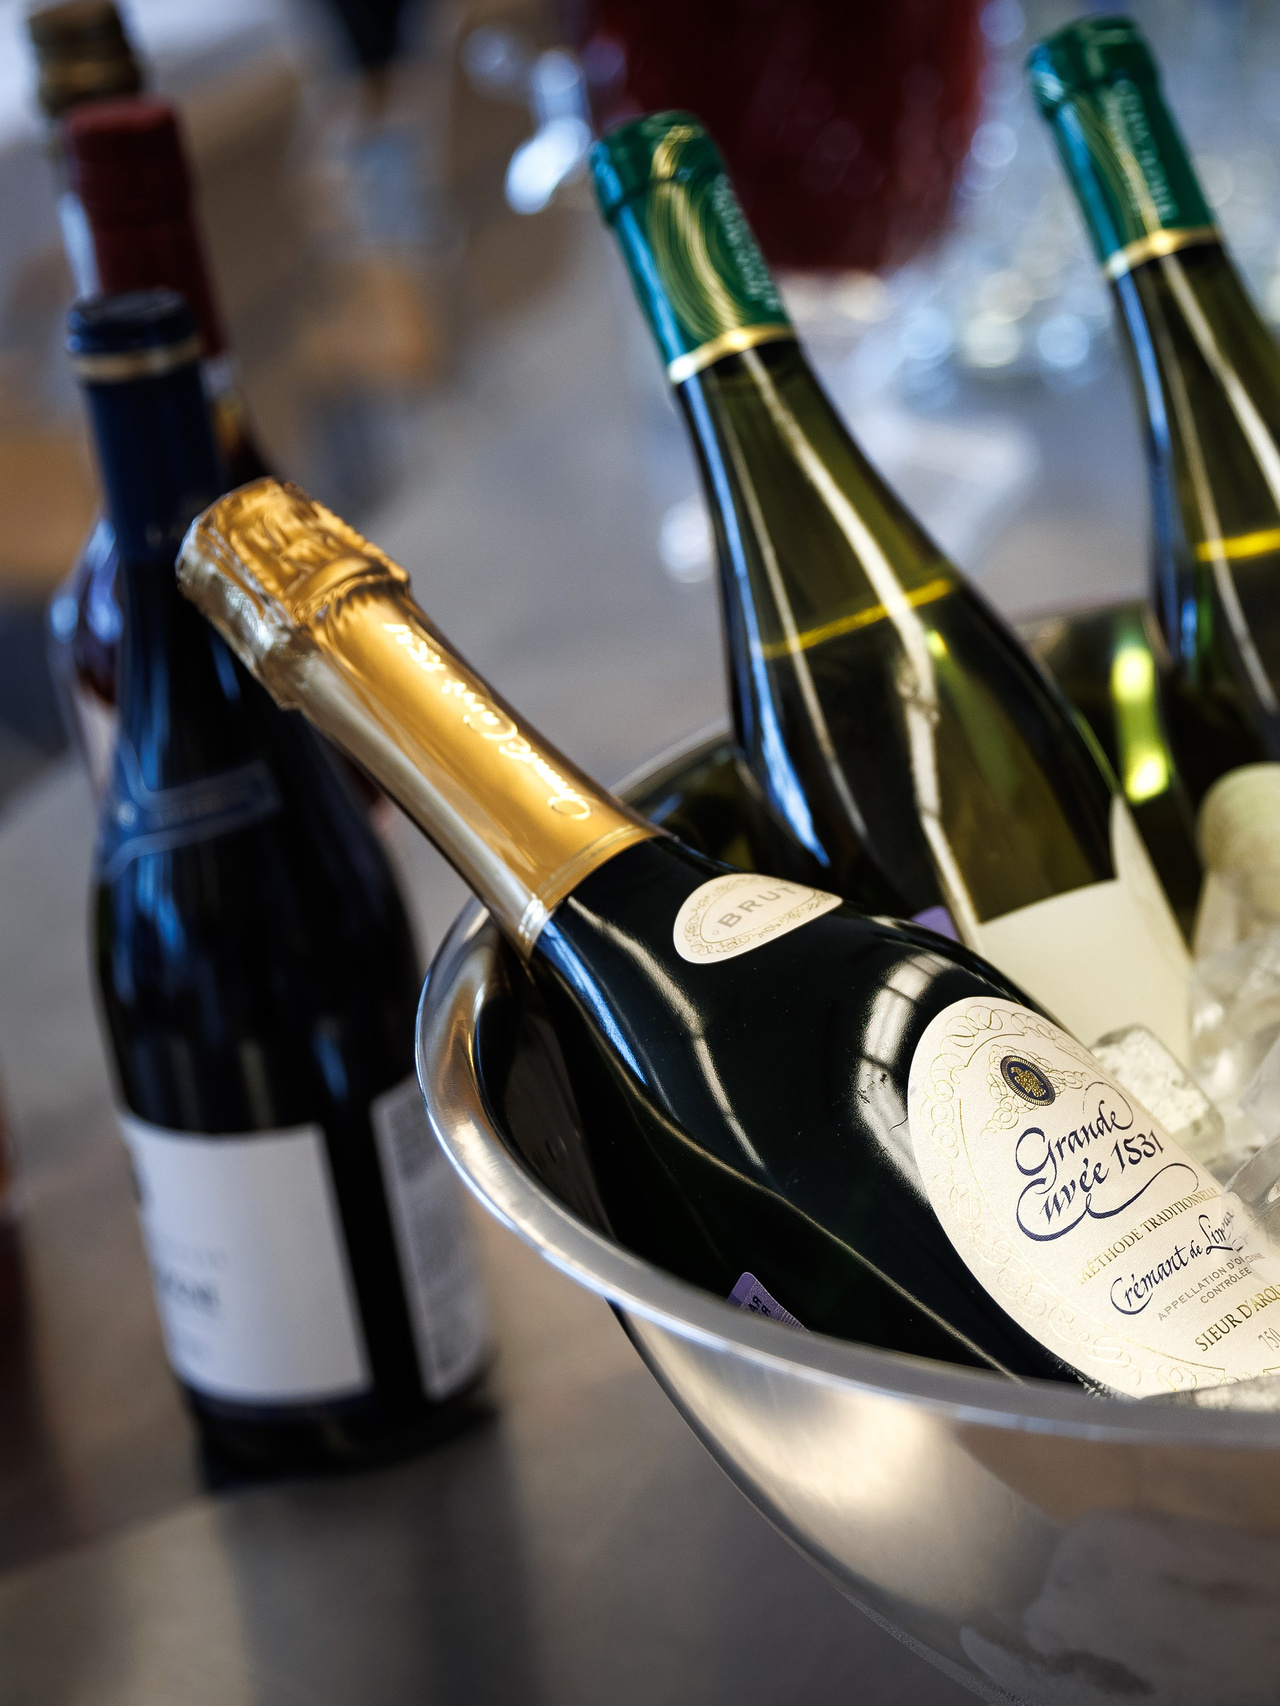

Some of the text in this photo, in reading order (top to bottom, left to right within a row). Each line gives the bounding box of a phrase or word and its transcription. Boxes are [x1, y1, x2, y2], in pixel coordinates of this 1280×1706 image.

[717, 886, 797, 928] BRUT
[1015, 1082, 1134, 1194] Grande
[1015, 1129, 1165, 1242] Cuvée 1531
[1078, 1187, 1221, 1285] MÉTHODE TRADITIONNELLE
[1109, 1245, 1189, 1315] Crémant
[1189, 1239, 1204, 1259] de
[1157, 1252, 1266, 1321] APPELLATION D'OGINE
[1199, 1266, 1253, 1304] CONTRÔLÉE
[1194, 1313, 1243, 1352] SIEUR
